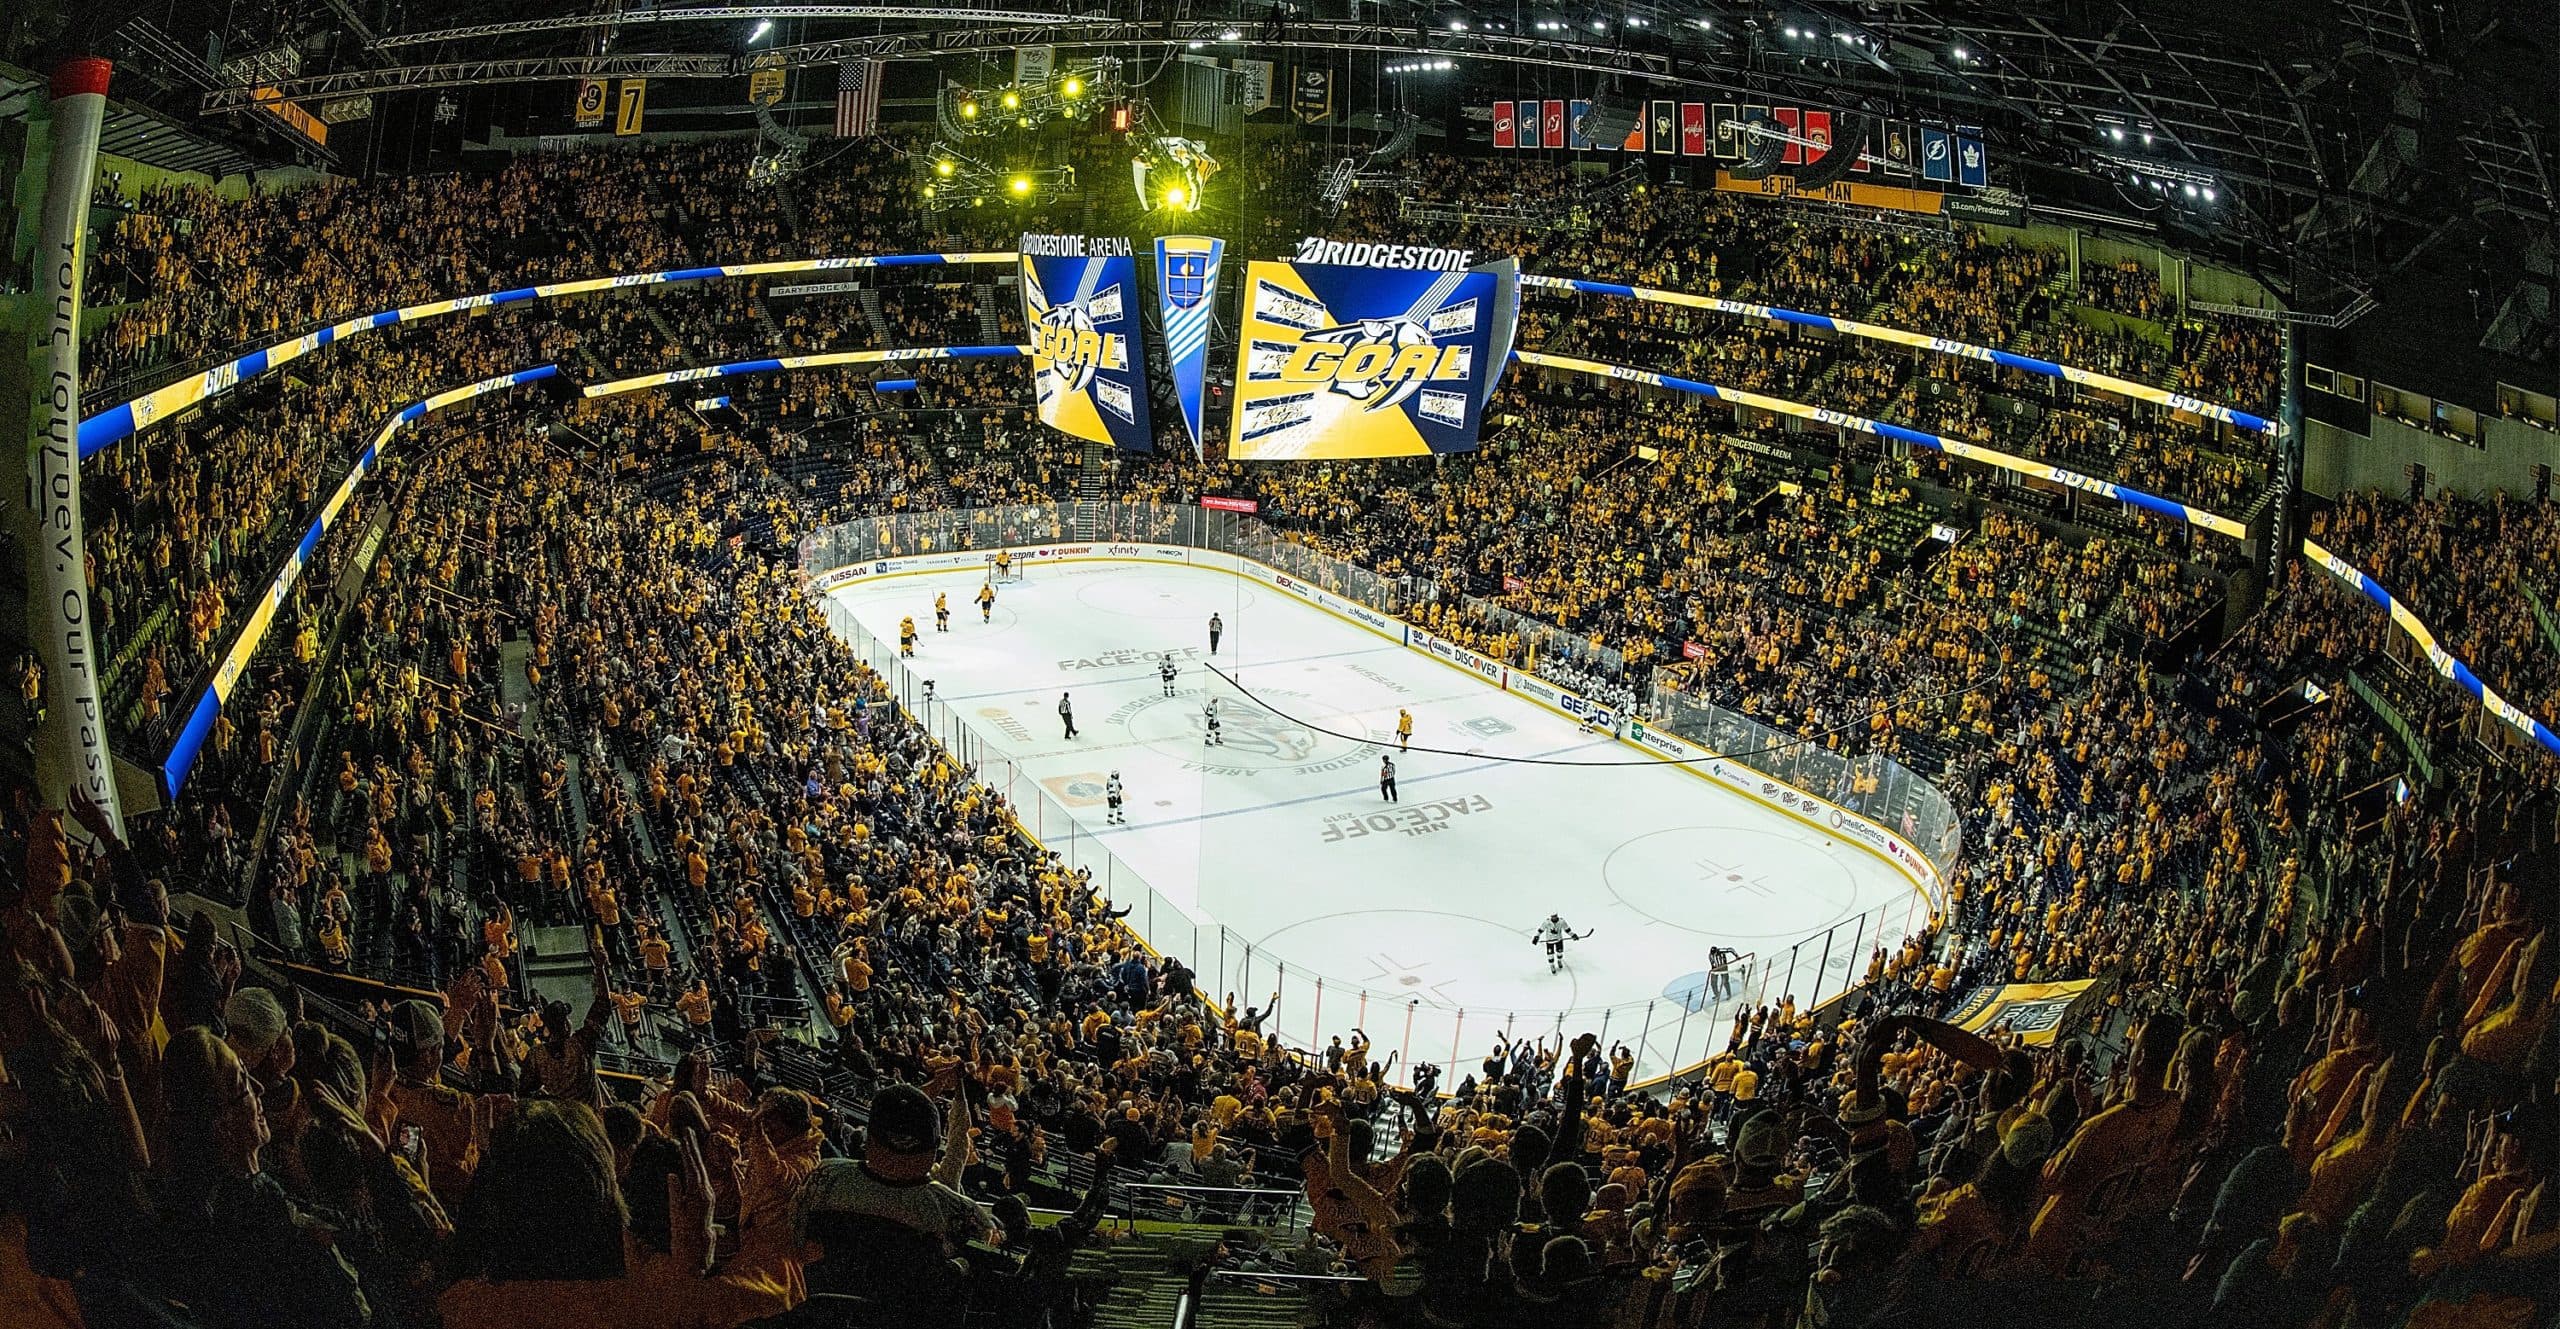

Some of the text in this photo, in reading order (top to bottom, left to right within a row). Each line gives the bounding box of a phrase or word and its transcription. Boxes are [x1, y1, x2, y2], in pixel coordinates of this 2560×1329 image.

[623, 86, 642, 133] 7
[1761, 177, 1776, 194] BE
[1825, 184, 1852, 202] MAN
[1950, 202, 2010, 217] 53.com/Predators
[1022, 231, 1133, 257] BRIDGESTONE ARENA
[1294, 236, 1474, 272] BRIDGESTONE
[778, 283, 841, 296] GARY FORCE
[1039, 324, 1122, 372] GOAL
[1281, 342, 1464, 383] GOAL
[1771, 447, 1793, 461] ARENA
[1058, 546, 1092, 556] DUNKIN'
[1107, 545, 1140, 556] xfinity
[830, 567, 867, 583] NISSAN
[1276, 575, 1293, 589] DEX
[1354, 608, 1385, 628] MassMutual
[62, 588, 88, 679] Our
[1057, 646, 1200, 672] FACE-OFF
[1454, 649, 1498, 678] DISCOVER
[1634, 727, 1683, 755] enterprise
[1320, 794, 1494, 843] FACE-OFF
[1398, 821, 1449, 837] NHL
[1842, 815, 1885, 844] IntelliCentrics
[2027, 1002, 2070, 1030] BUILT
